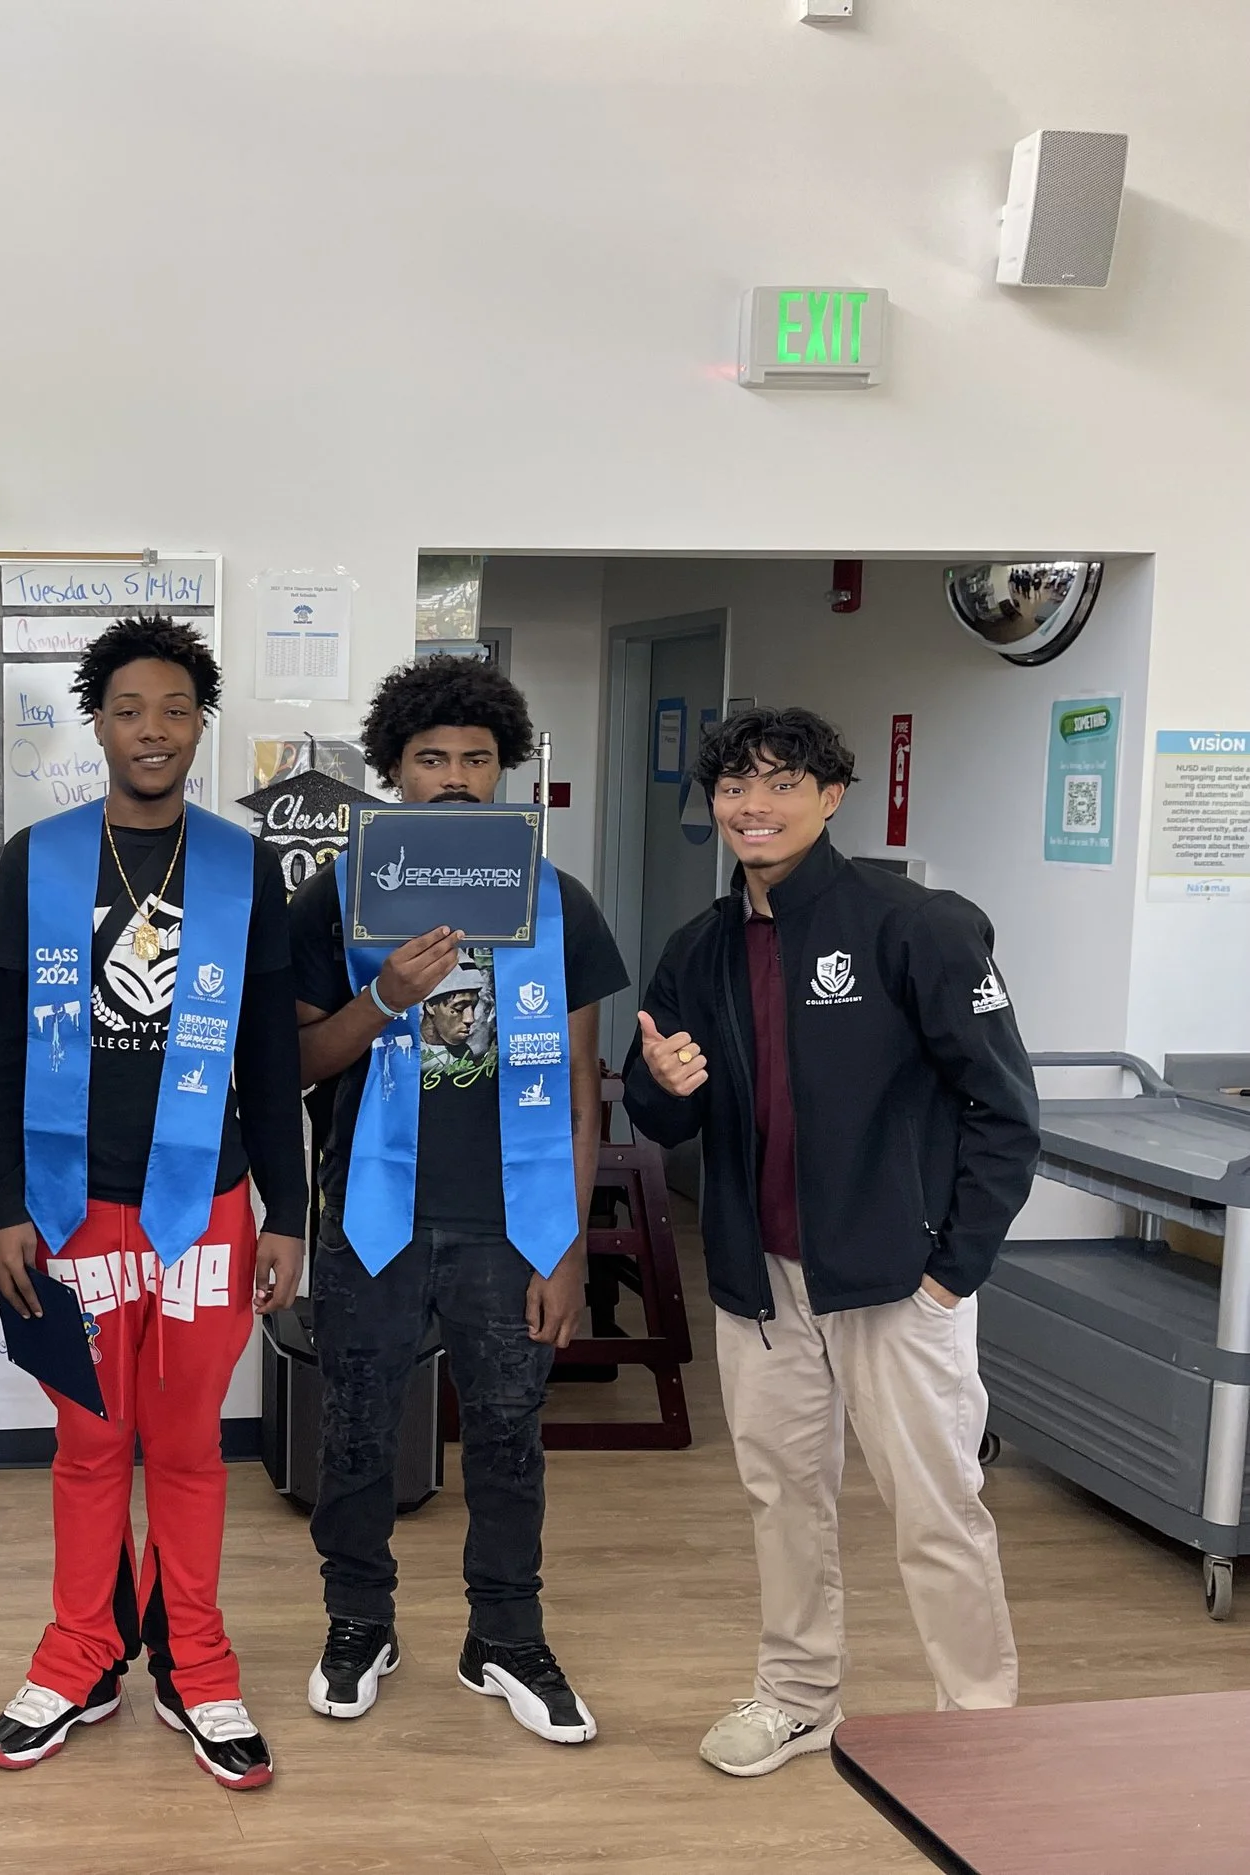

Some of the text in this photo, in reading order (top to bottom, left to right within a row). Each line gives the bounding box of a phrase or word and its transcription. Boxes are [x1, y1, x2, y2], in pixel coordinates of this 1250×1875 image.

[777, 291, 869, 363] EXIT
[7, 569, 203, 605] Tuesday 5/14/24
[895, 722, 909, 733] FIRE
[1189, 735, 1246, 751] VISION
[9, 739, 103, 781] Quarter
[1176, 764, 1199, 772] NUSD
[1180, 774, 1216, 783] engaging
[1165, 782, 1196, 791] learning
[1197, 783, 1240, 791] community
[267, 794, 338, 830] Class
[1166, 816, 1228, 824] social-emotional
[1178, 834, 1212, 842] prepared
[1176, 851, 1203, 859] college
[405, 866, 522, 879] GRADUATION
[404, 877, 521, 887] CELEBRATION
[36, 948, 79, 963] CLASS
[36, 967, 79, 985] 2024
[834, 996, 863, 1004] ACADEMY
[179, 1013, 228, 1028] LIBERATION
[132, 1021, 162, 1033] IYT
[177, 1021, 227, 1039] SERVICE
[176, 1033, 227, 1047] CHARACTER
[509, 1032, 560, 1043] LIBERATION
[175, 1040, 226, 1053] TEAMWORK
[509, 1040, 560, 1054] SERVICE
[509, 1052, 562, 1061] CHARACTER
[509, 1059, 562, 1067] TEAMWORK
